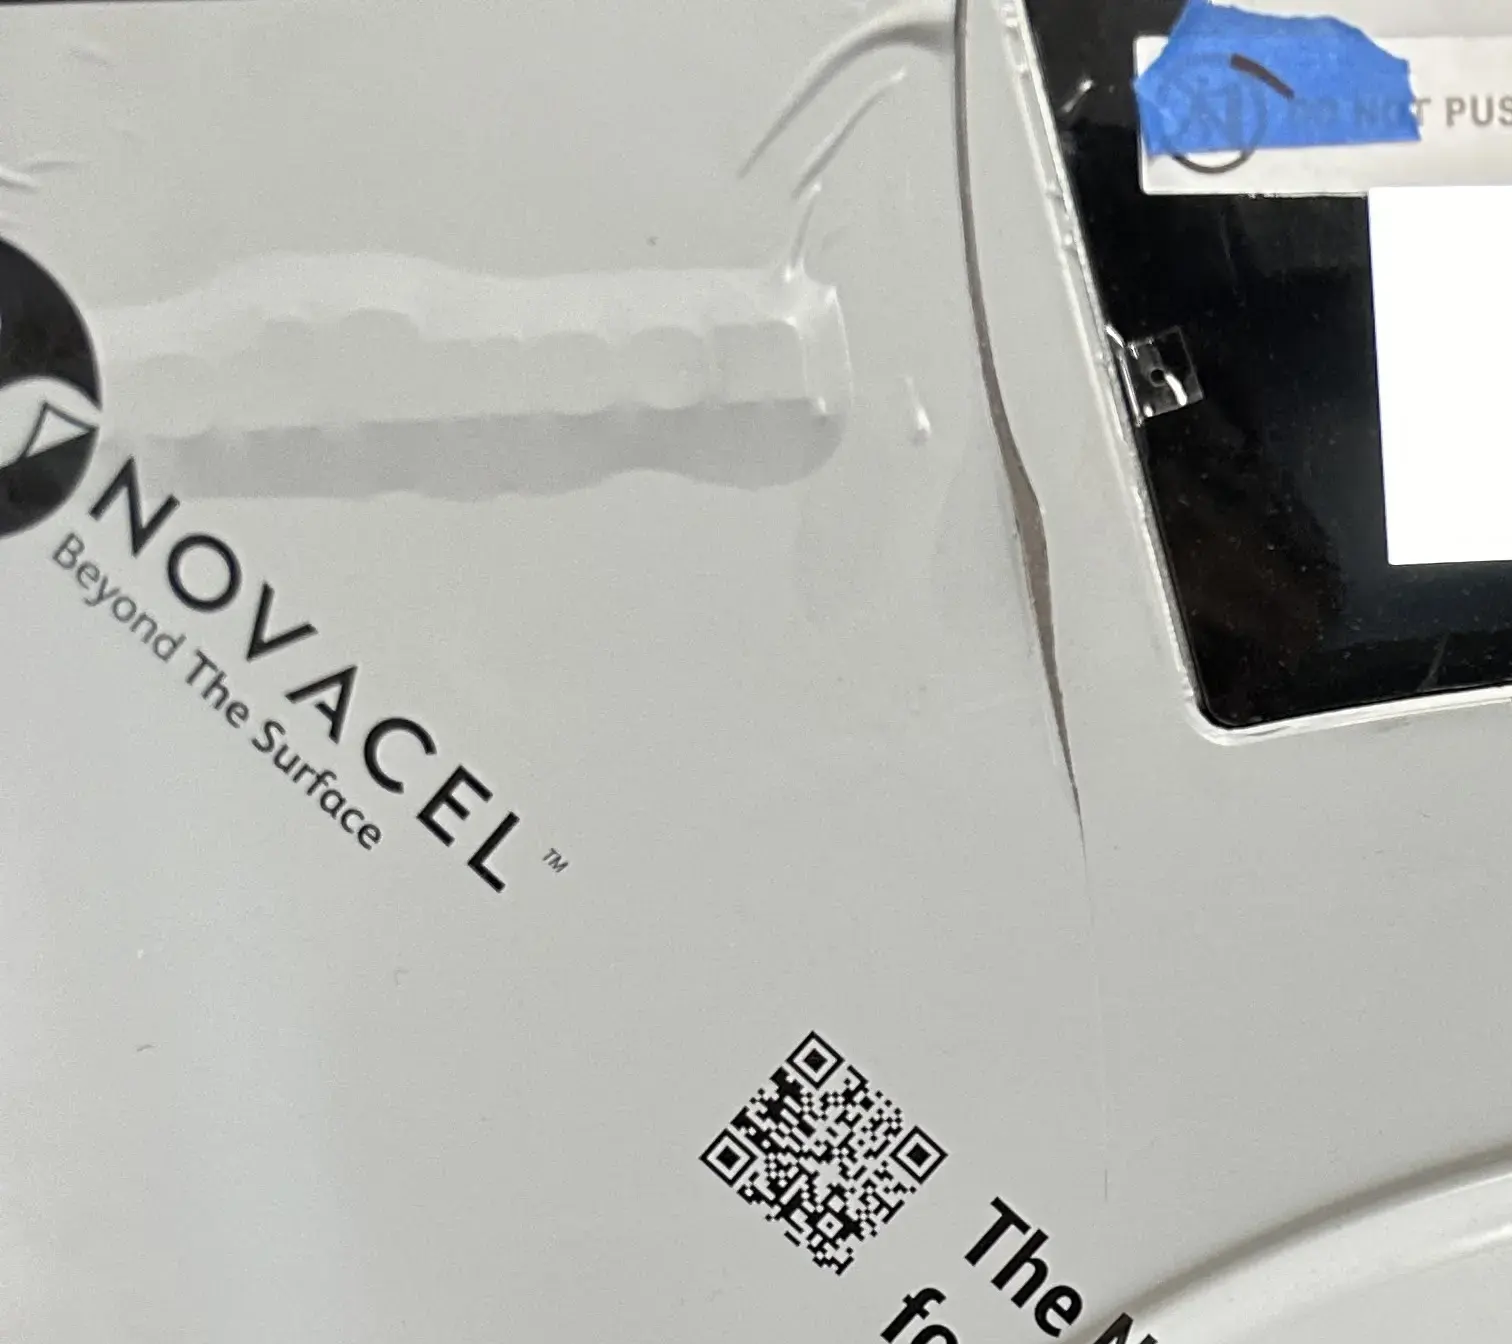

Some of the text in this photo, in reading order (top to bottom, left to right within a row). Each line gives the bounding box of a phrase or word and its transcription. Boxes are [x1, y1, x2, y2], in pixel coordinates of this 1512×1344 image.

[52, 532, 385, 852] Beyond The Surface
[88, 456, 522, 893] NOVACEL
[963, 1195, 1085, 1339] The
